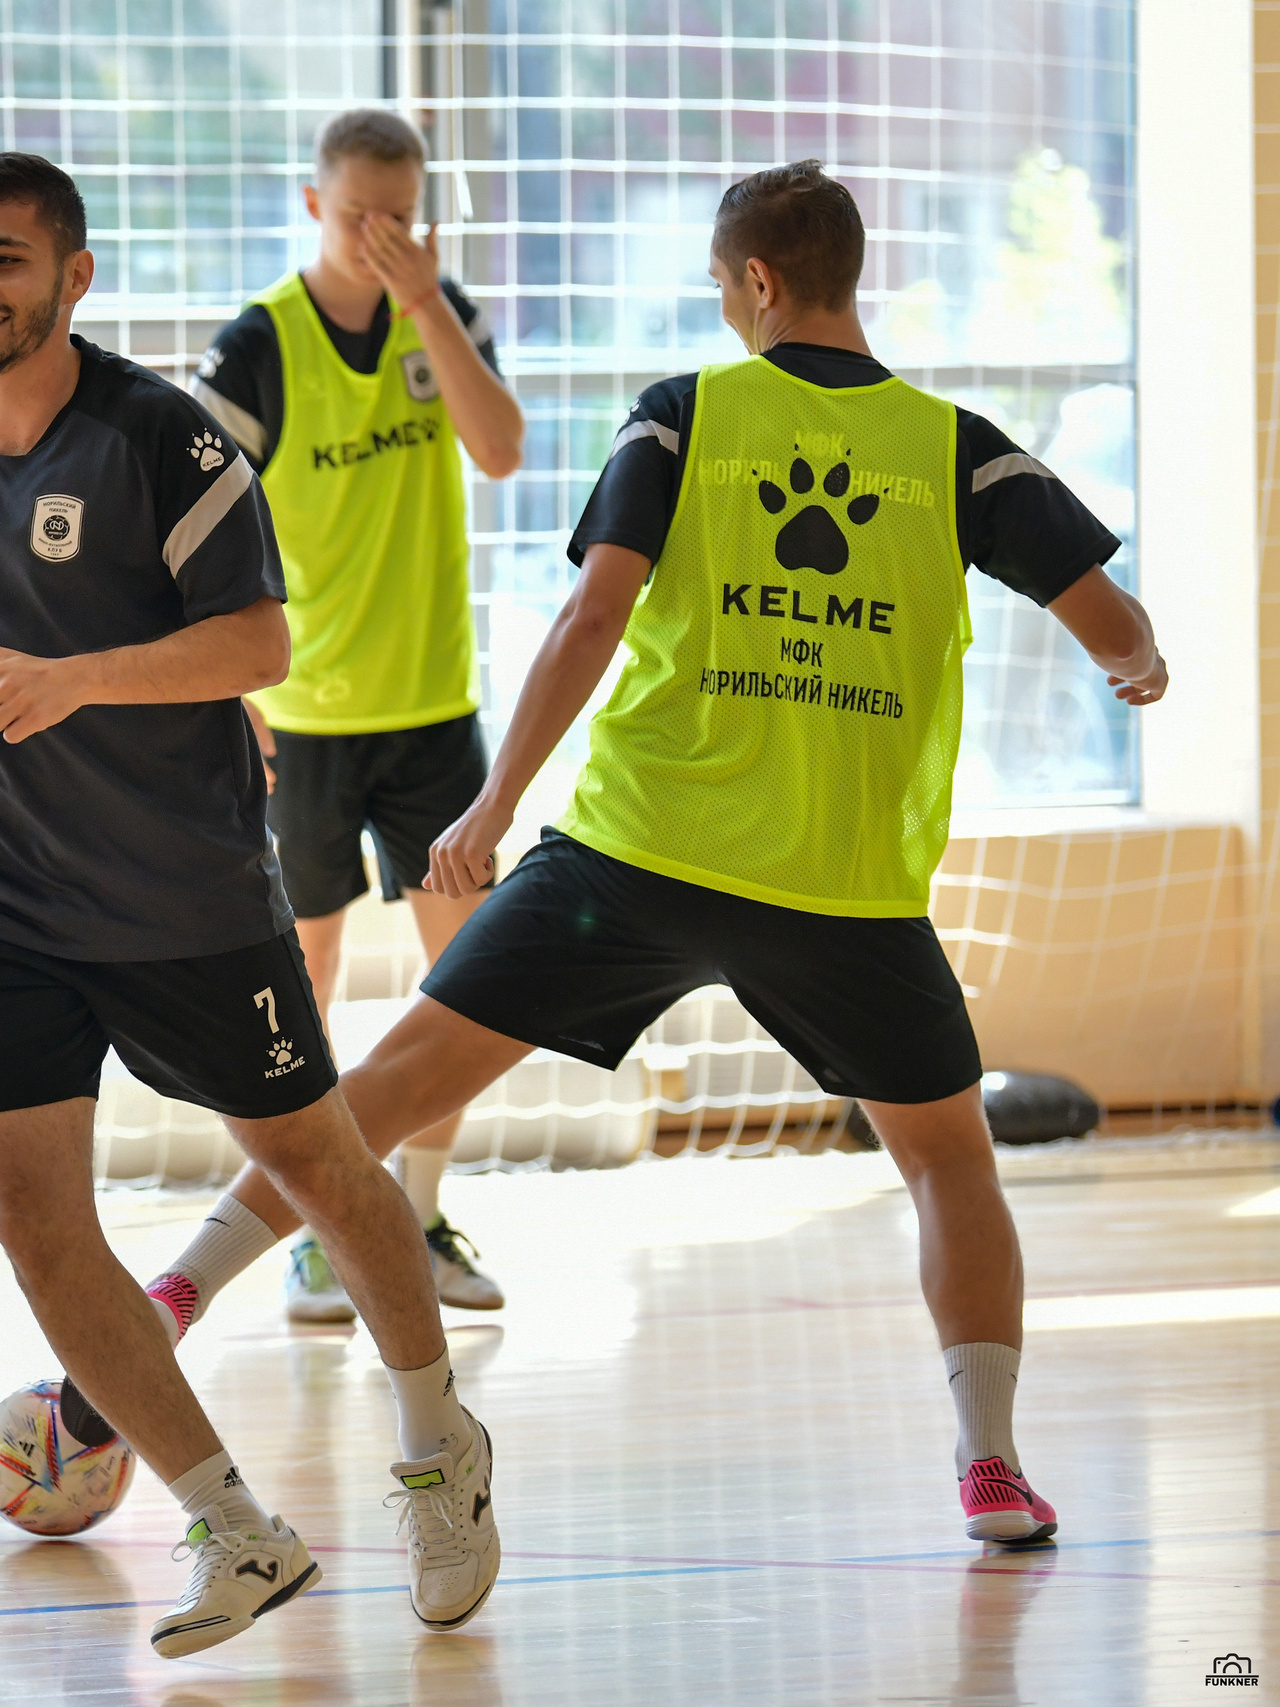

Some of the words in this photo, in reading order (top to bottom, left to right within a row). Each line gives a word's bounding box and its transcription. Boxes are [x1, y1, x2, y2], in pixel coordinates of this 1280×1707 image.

[849, 469, 936, 508] НИКЕЛЬ
[722, 583, 896, 635] KELME
[780, 636, 824, 668] МФК
[699, 667, 823, 705] НОРИЛЬСКИЙ
[827, 682, 904, 719] НИКЕЛЬ
[253, 986, 280, 1034] 7
[264, 1055, 306, 1079] KELME
